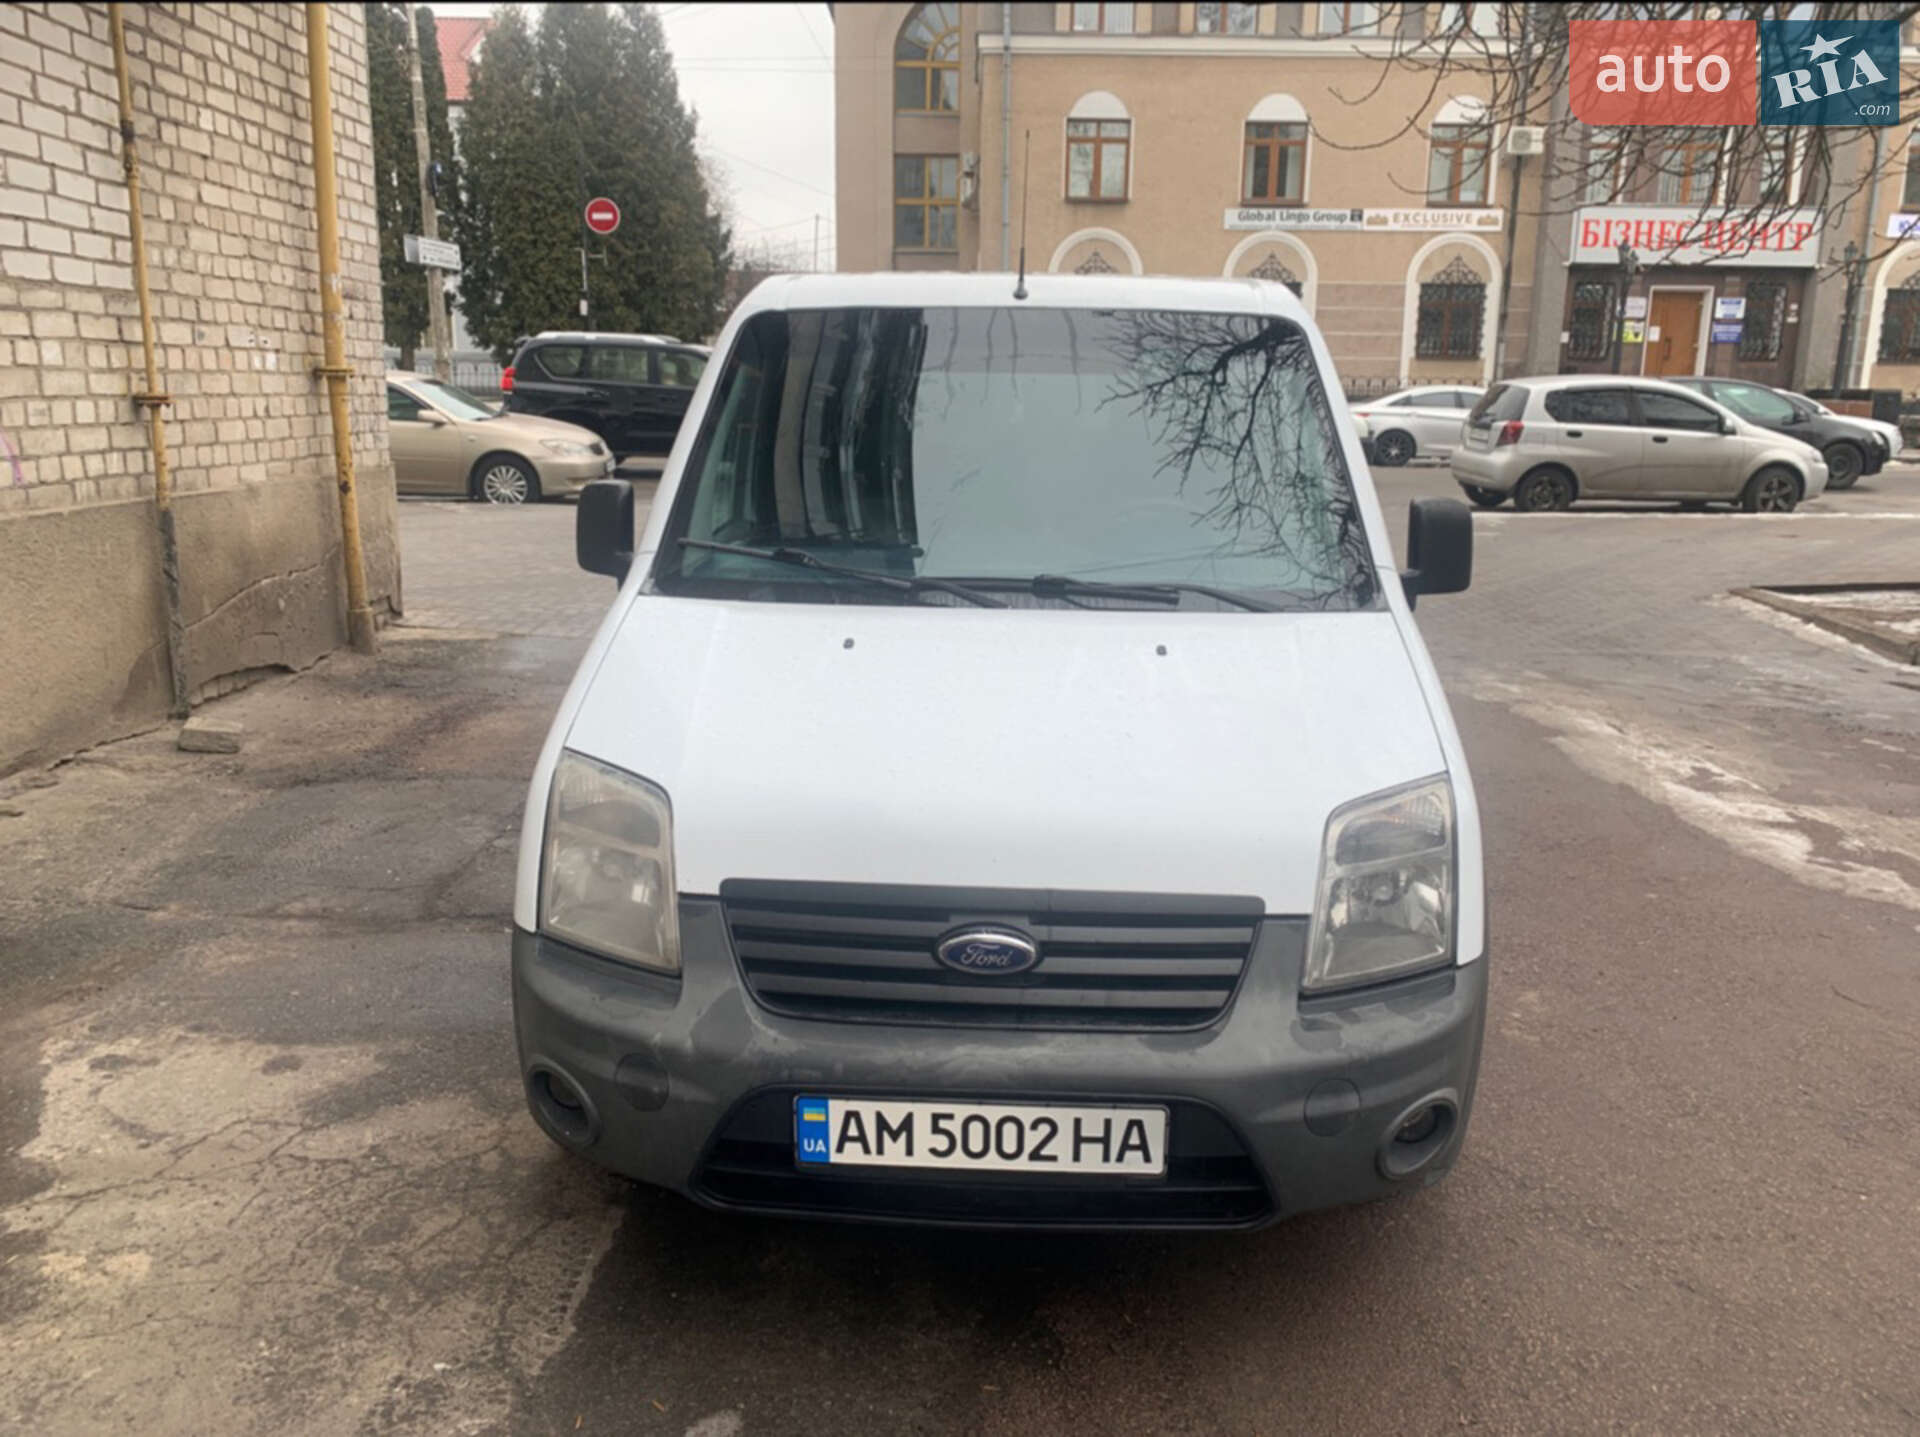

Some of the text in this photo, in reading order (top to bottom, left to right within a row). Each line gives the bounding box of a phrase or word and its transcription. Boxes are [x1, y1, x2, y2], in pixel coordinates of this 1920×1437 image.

[1237, 210, 1348, 225] Global Lingo Group
[1392, 211, 1474, 224] EXCLUSIVE
[1580, 218, 1814, 252] БІЗНЕС ЦЕНТР
[961, 942, 1014, 968] Ford
[803, 1138, 827, 1153] UA
[835, 1110, 1153, 1164] AM 5002 HA
